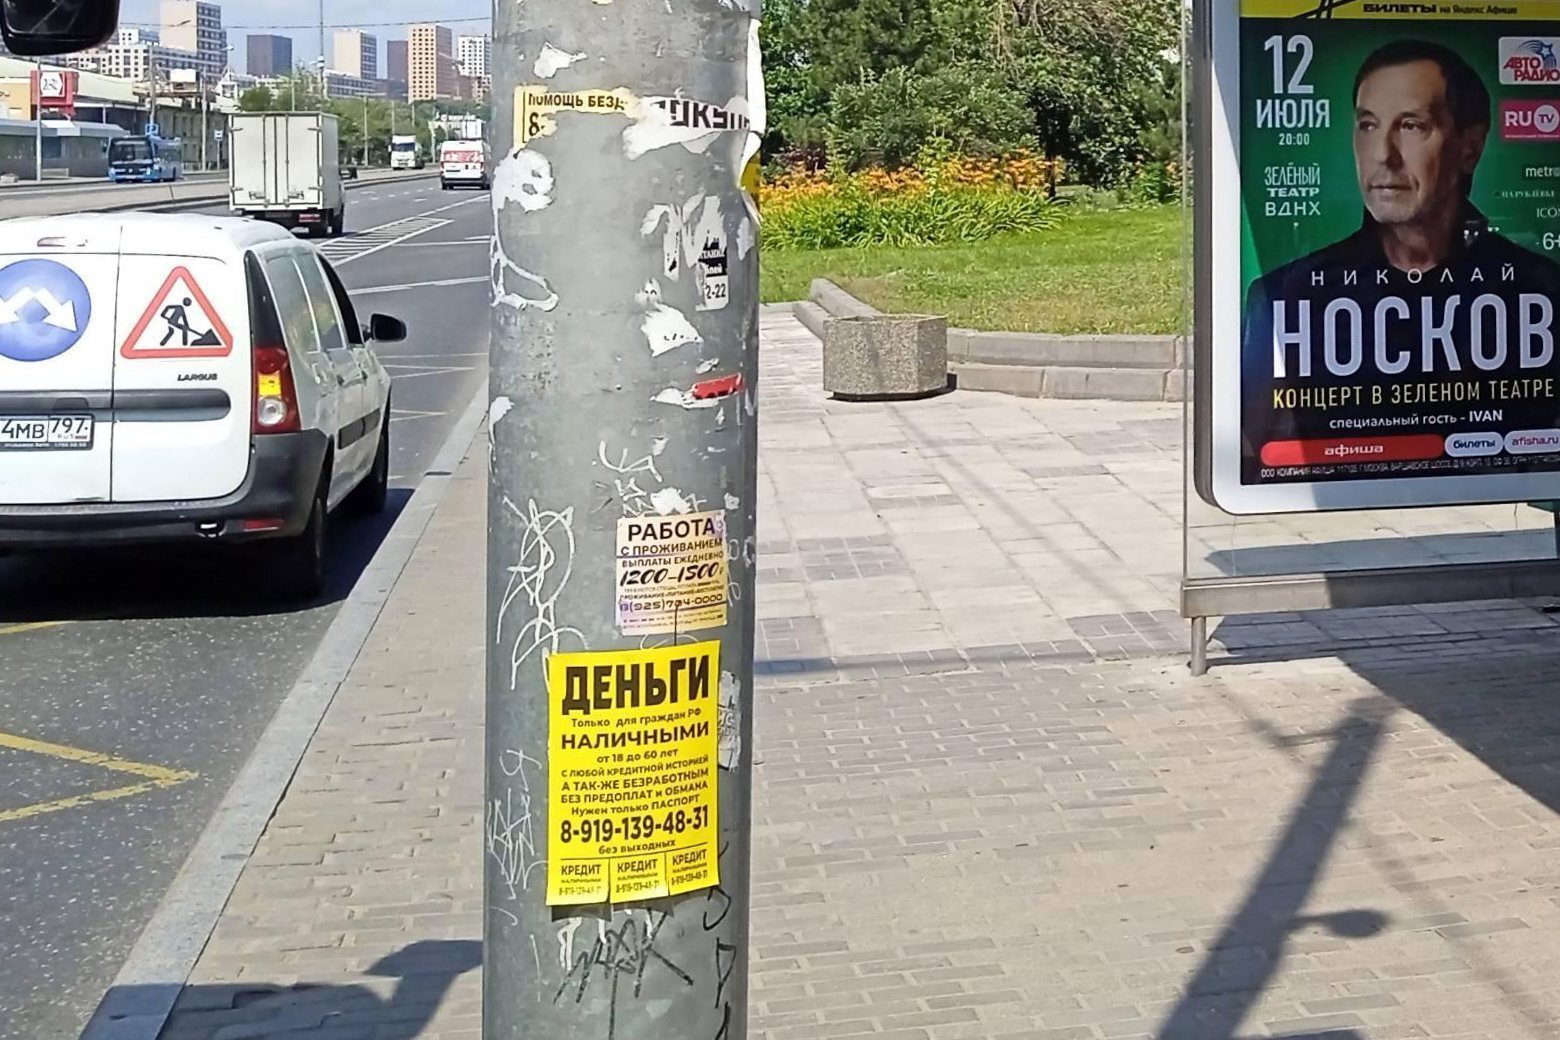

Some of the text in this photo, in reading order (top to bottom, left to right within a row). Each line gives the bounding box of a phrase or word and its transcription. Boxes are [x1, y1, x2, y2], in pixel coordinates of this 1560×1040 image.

[1363, 3, 1437, 14] БИЛЕТЫ
[1264, 34, 1314, 94] 12
[1502, 56, 1541, 70] АВТО
[1256, 99, 1331, 129] ИЮЛЯ
[1504, 111, 1532, 127] RU
[1278, 133, 1310, 146] 20:00
[1266, 187, 1320, 198] ТЕАТР
[1265, 201, 1321, 217] ВДНХ
[1310, 263, 1516, 287] НИКОЛАЙ
[1272, 293, 1555, 379] НОСКОВ
[177, 373, 218, 381] LARGUS
[1273, 378, 1555, 410] КОНЦЕРТ В ЗЕЛЕНОМ ТЕАТРЕ
[50, 418, 86, 434] 797
[1329, 413, 1419, 430] специальный
[1422, 414, 1458, 425] гость
[1468, 409, 1504, 423] IVAN
[1324, 436, 1559, 457] афиша билеты afisha.ru
[627, 517, 716, 542] РАБОТА
[620, 537, 723, 557] С ПРОЖИВАНИЕМ
[622, 550, 724, 568] ВЫПЛАТЫ ЕЖЕДНЕВНО
[561, 654, 710, 716] ДЕНЬГИ
[571, 707, 702, 728] Только для граждан РФ
[561, 720, 709, 750] НАЛИЧНЫМИ
[596, 748, 679, 763] от 18 до 60 лет
[561, 755, 709, 778] С ЛЮБОЙ КРЕДИТНОЙ ИСТОРИЕЙ
[561, 767, 709, 792] А ТАК-ЖЕ БЕЗРАБОТНЫМ
[561, 794, 581, 804] БЕЗ
[583, 789, 653, 804] ПРЕДОПЛАТ
[665, 780, 709, 797] ОБМАНА
[571, 793, 700, 818] Нужен только ПАСПОРТ
[560, 804, 709, 844] 8-919-139-48-31
[598, 839, 676, 855] без выходных
[672, 849, 708, 866] КРЕДИТ
[561, 864, 602, 876] КРЕДИТ
[617, 858, 658, 873] КРЕДИТ
